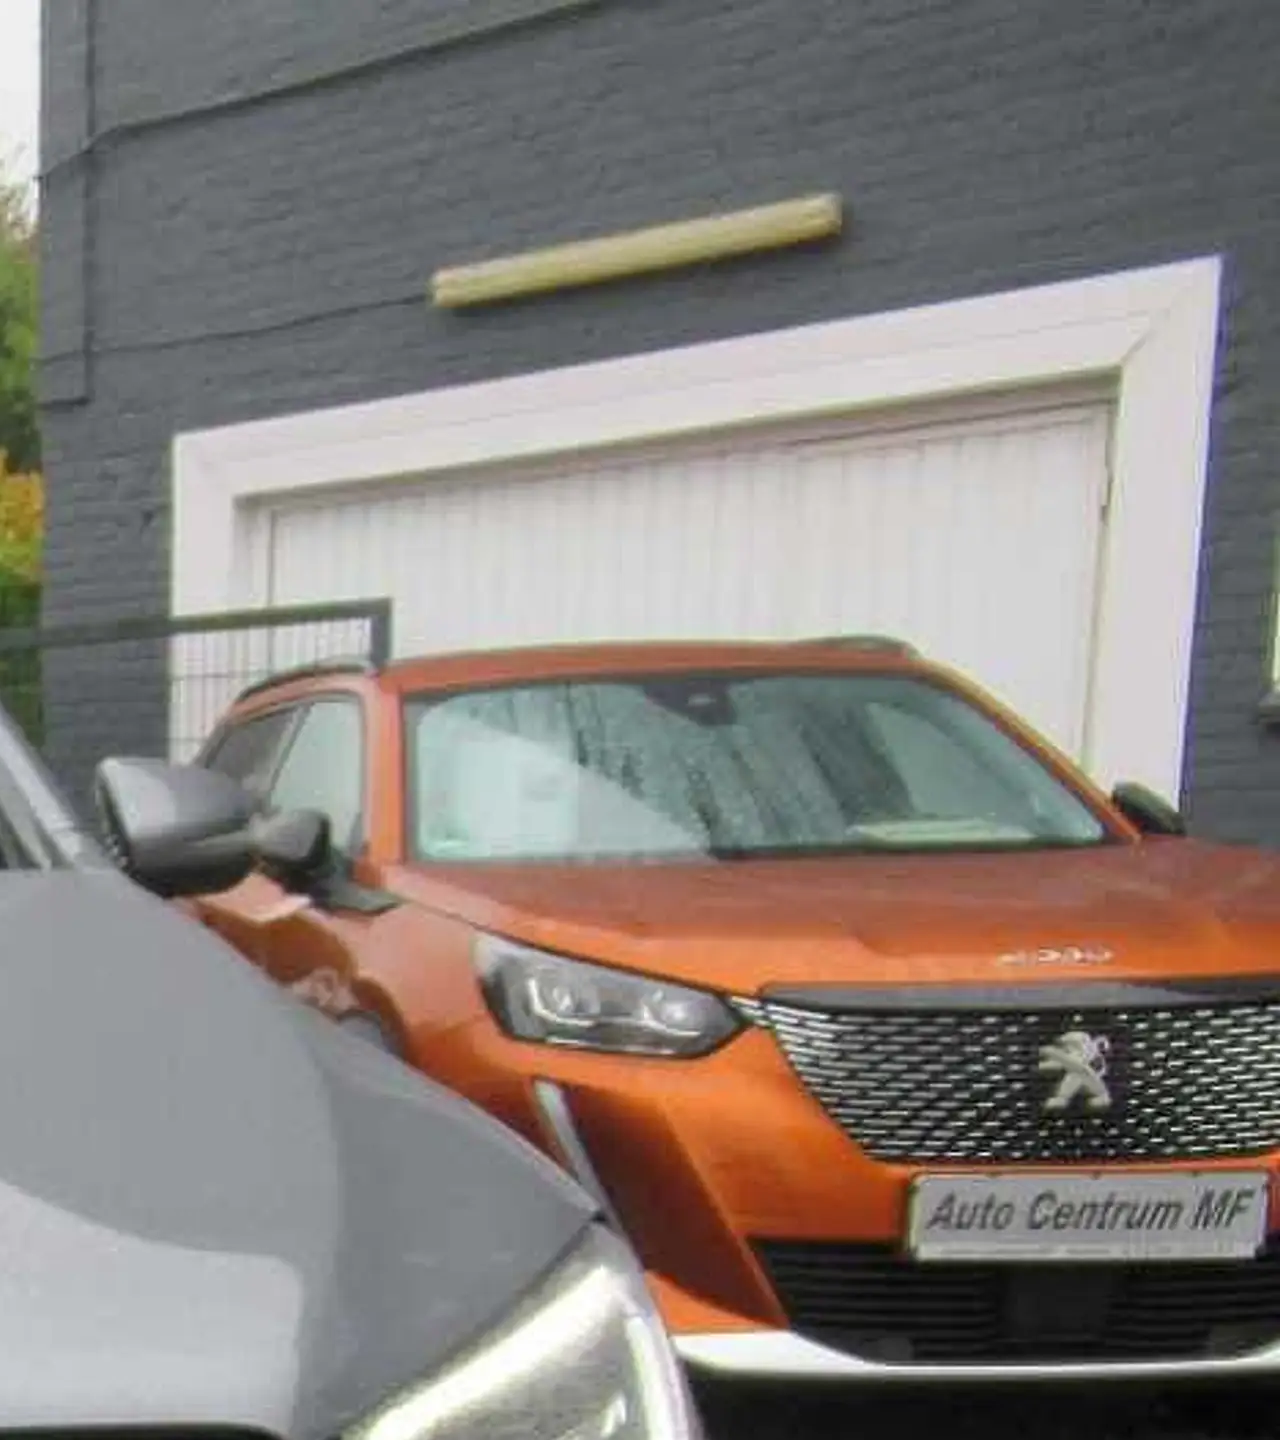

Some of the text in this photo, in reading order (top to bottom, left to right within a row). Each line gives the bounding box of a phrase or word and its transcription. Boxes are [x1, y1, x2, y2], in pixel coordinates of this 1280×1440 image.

[928, 1186, 1256, 1232] Auto Centrum MF
